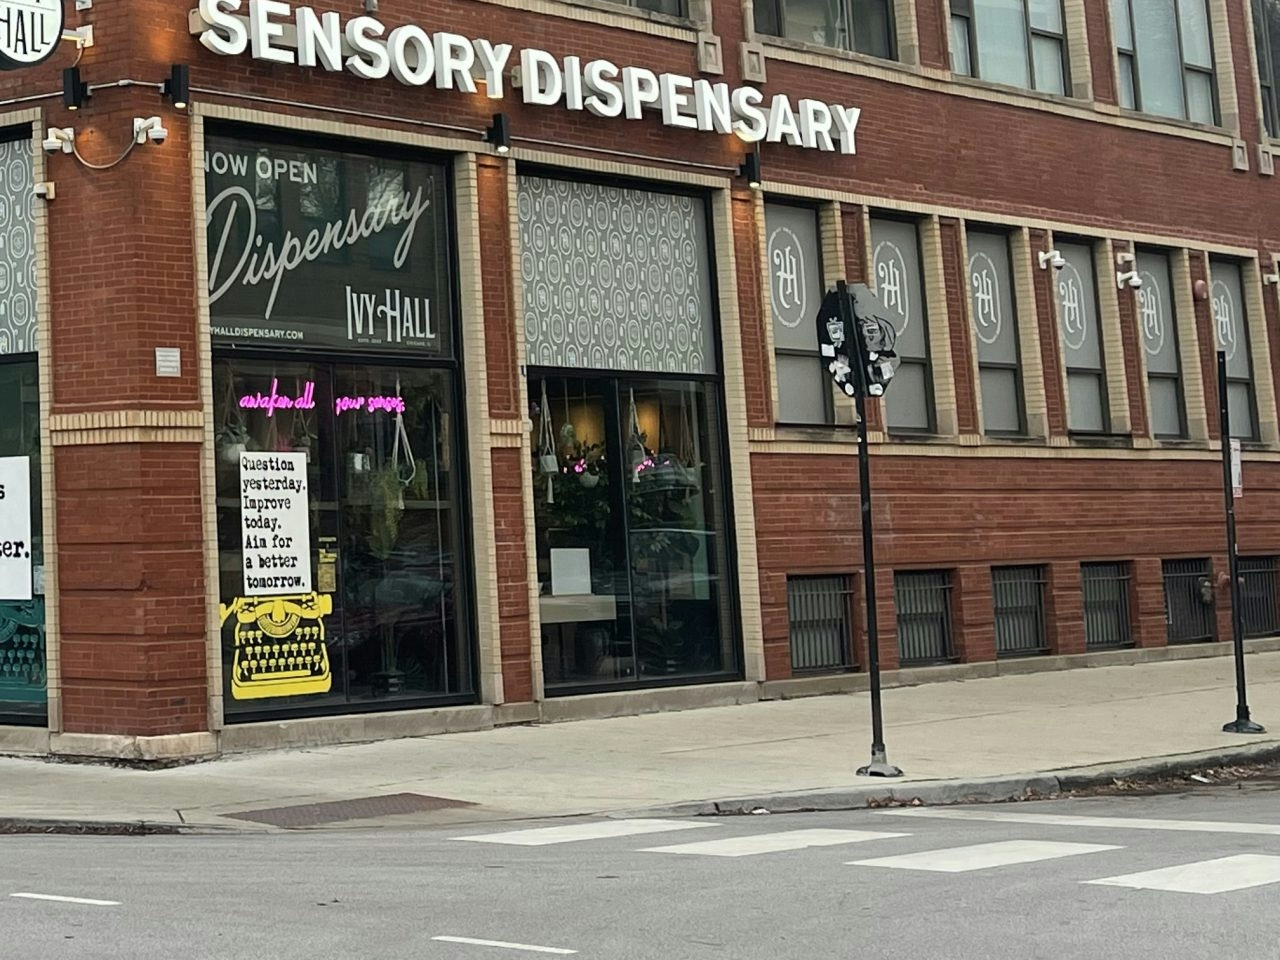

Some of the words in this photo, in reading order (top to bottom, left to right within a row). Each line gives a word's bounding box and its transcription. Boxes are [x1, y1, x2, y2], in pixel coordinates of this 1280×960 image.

[519, 47, 861, 155] DISPENSARY
[256, 157, 318, 184] OPEN
[206, 186, 430, 320] Dispensary
[346, 285, 377, 340] IVY
[377, 289, 436, 343] HALL
[295, 381, 315, 409] all
[336, 396, 365, 416] your
[242, 456, 295, 471] Question
[243, 476, 306, 493] yesterday.
[243, 496, 291, 513] Improve
[244, 515, 282, 532] today.
[245, 535, 267, 549] Aim
[272, 534, 293, 549] for
[245, 556, 253, 569] a
[258, 554, 298, 568] better
[246, 575, 305, 589] tomorrow.
